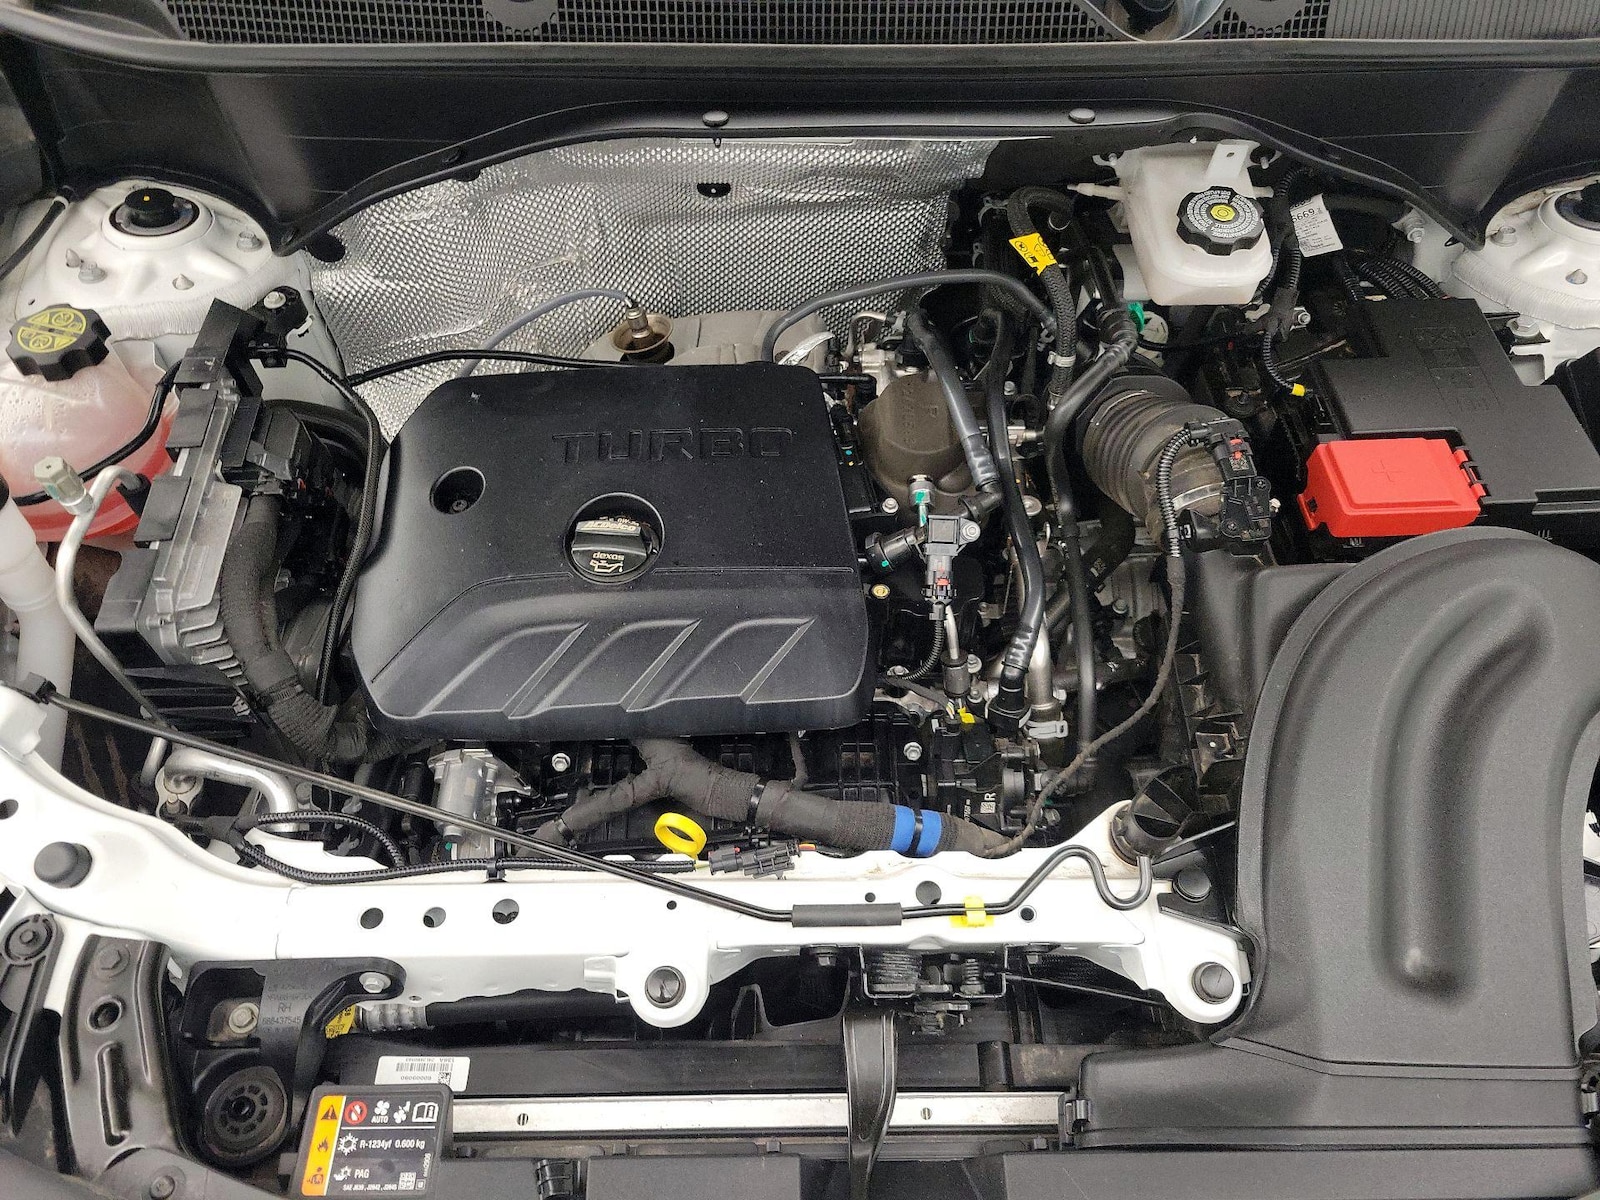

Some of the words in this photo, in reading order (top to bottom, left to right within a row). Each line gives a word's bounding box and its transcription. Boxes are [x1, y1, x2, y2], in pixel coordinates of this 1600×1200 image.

[552, 427, 793, 463] TURBO
[584, 520, 637, 531] ACDelco
[592, 551, 624, 561] dexos
[984, 792, 997, 801] R
[277, 1002, 292, 1013] RH
[371, 1115, 389, 1124] AUTO
[359, 1139, 392, 1150] R-1234yf
[395, 1140, 415, 1149] 0.600
[415, 1139, 426, 1150] kg
[354, 1168, 370, 1179] PAG
